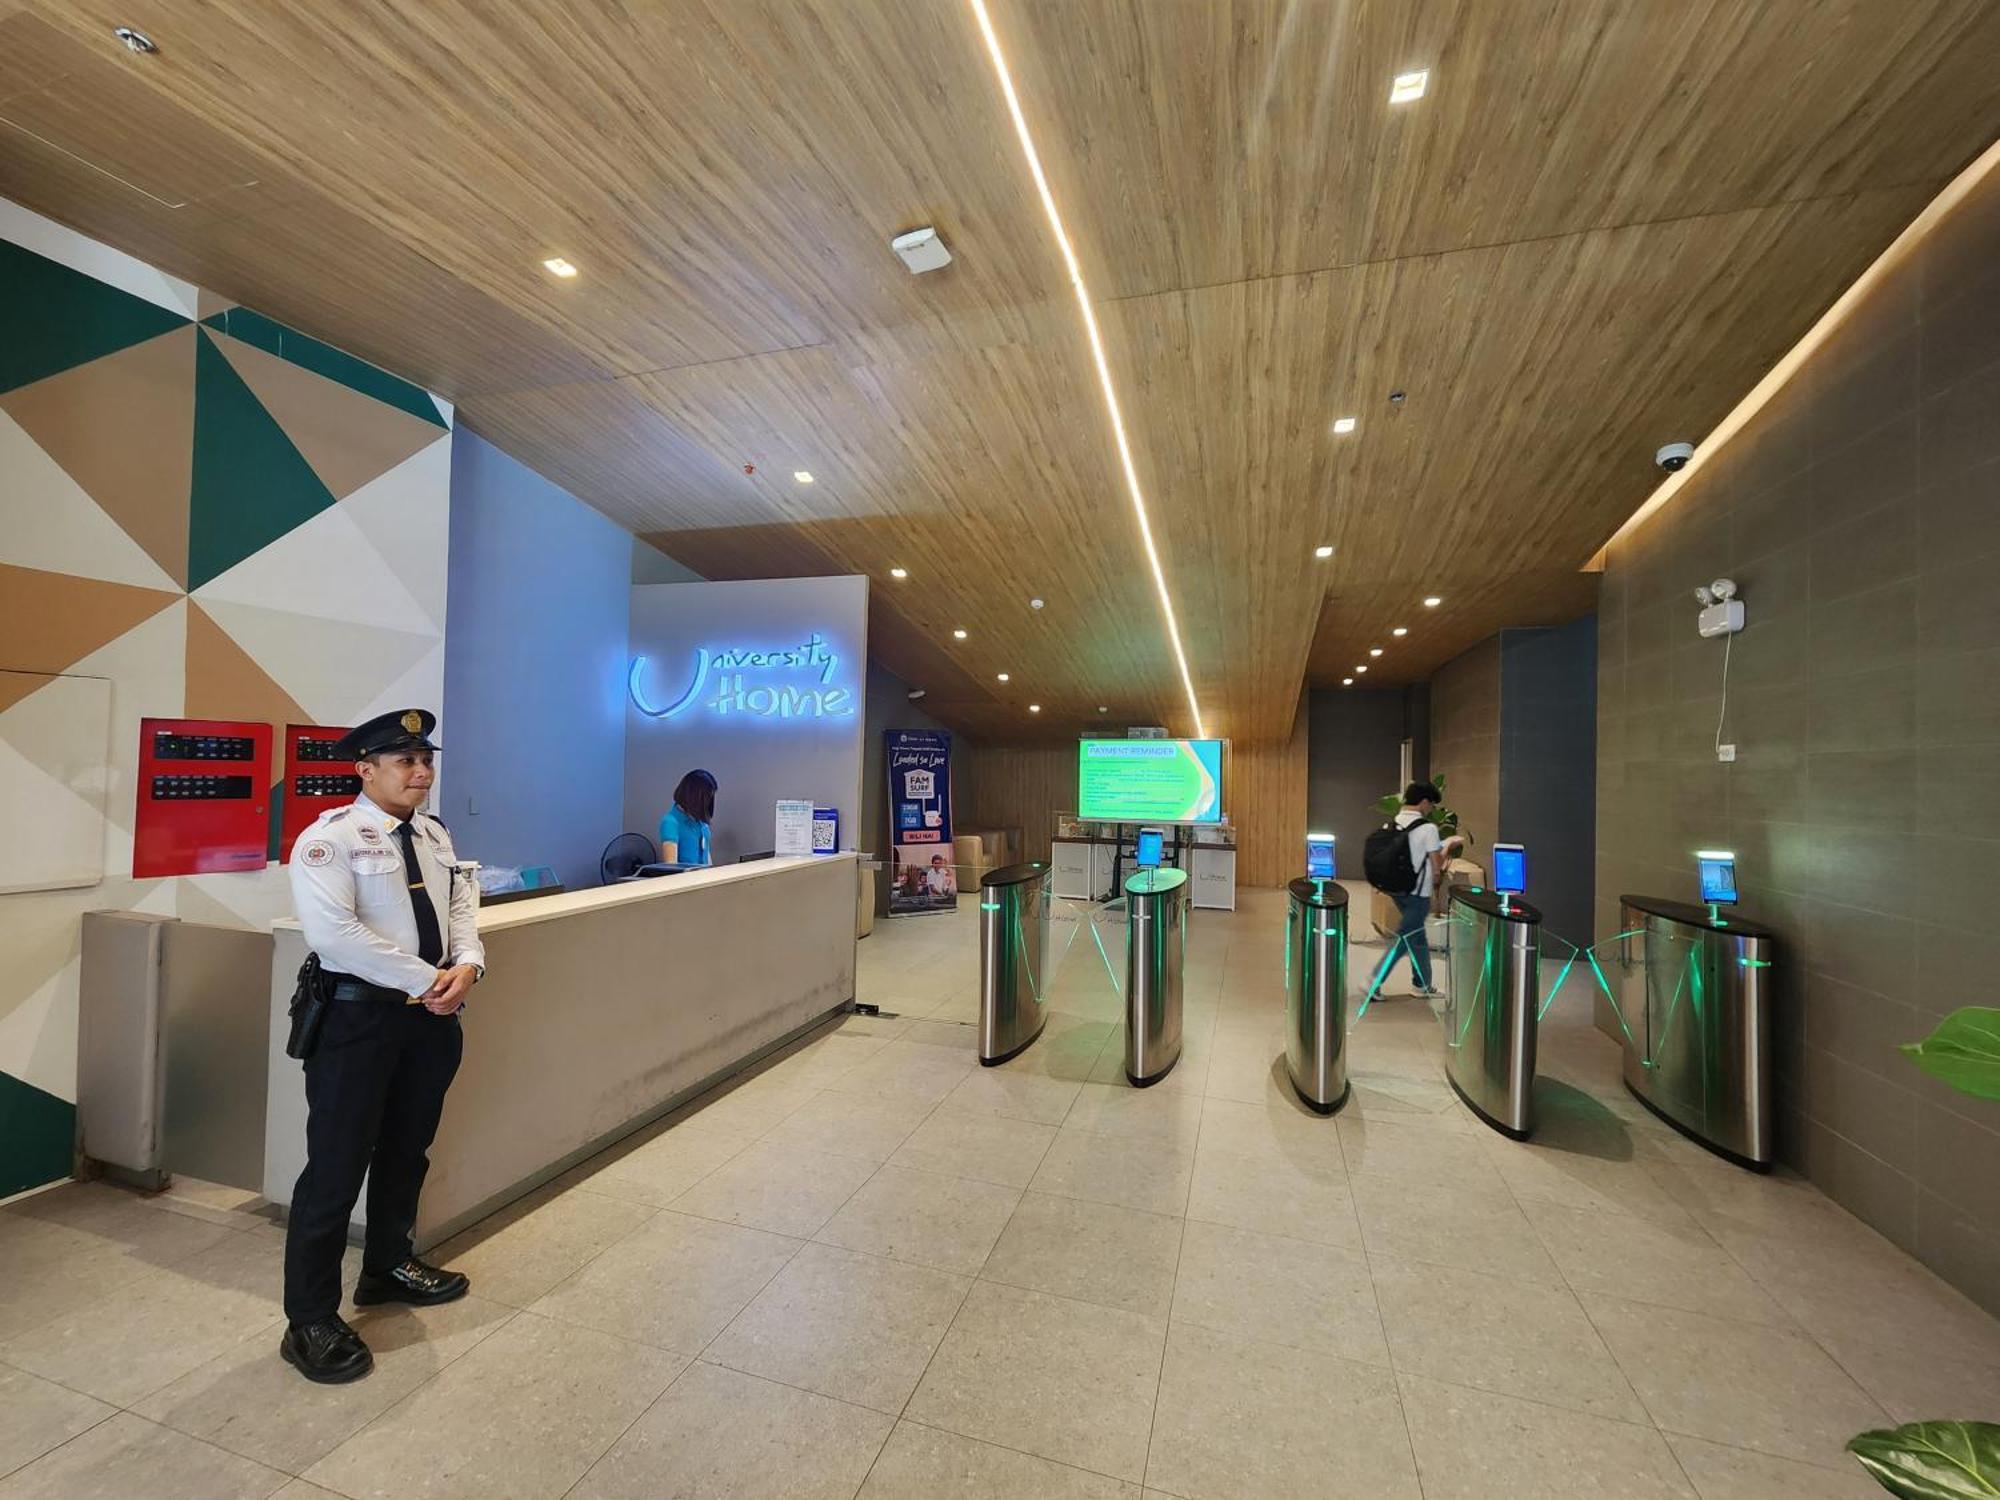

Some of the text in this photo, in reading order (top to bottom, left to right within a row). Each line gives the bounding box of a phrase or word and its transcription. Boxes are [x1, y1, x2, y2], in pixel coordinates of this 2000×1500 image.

[628, 633, 838, 718] University
[708, 673, 855, 718] Home
[1089, 746, 1175, 756] PAYMENT REMINDER
[910, 776, 929, 784] FAM
